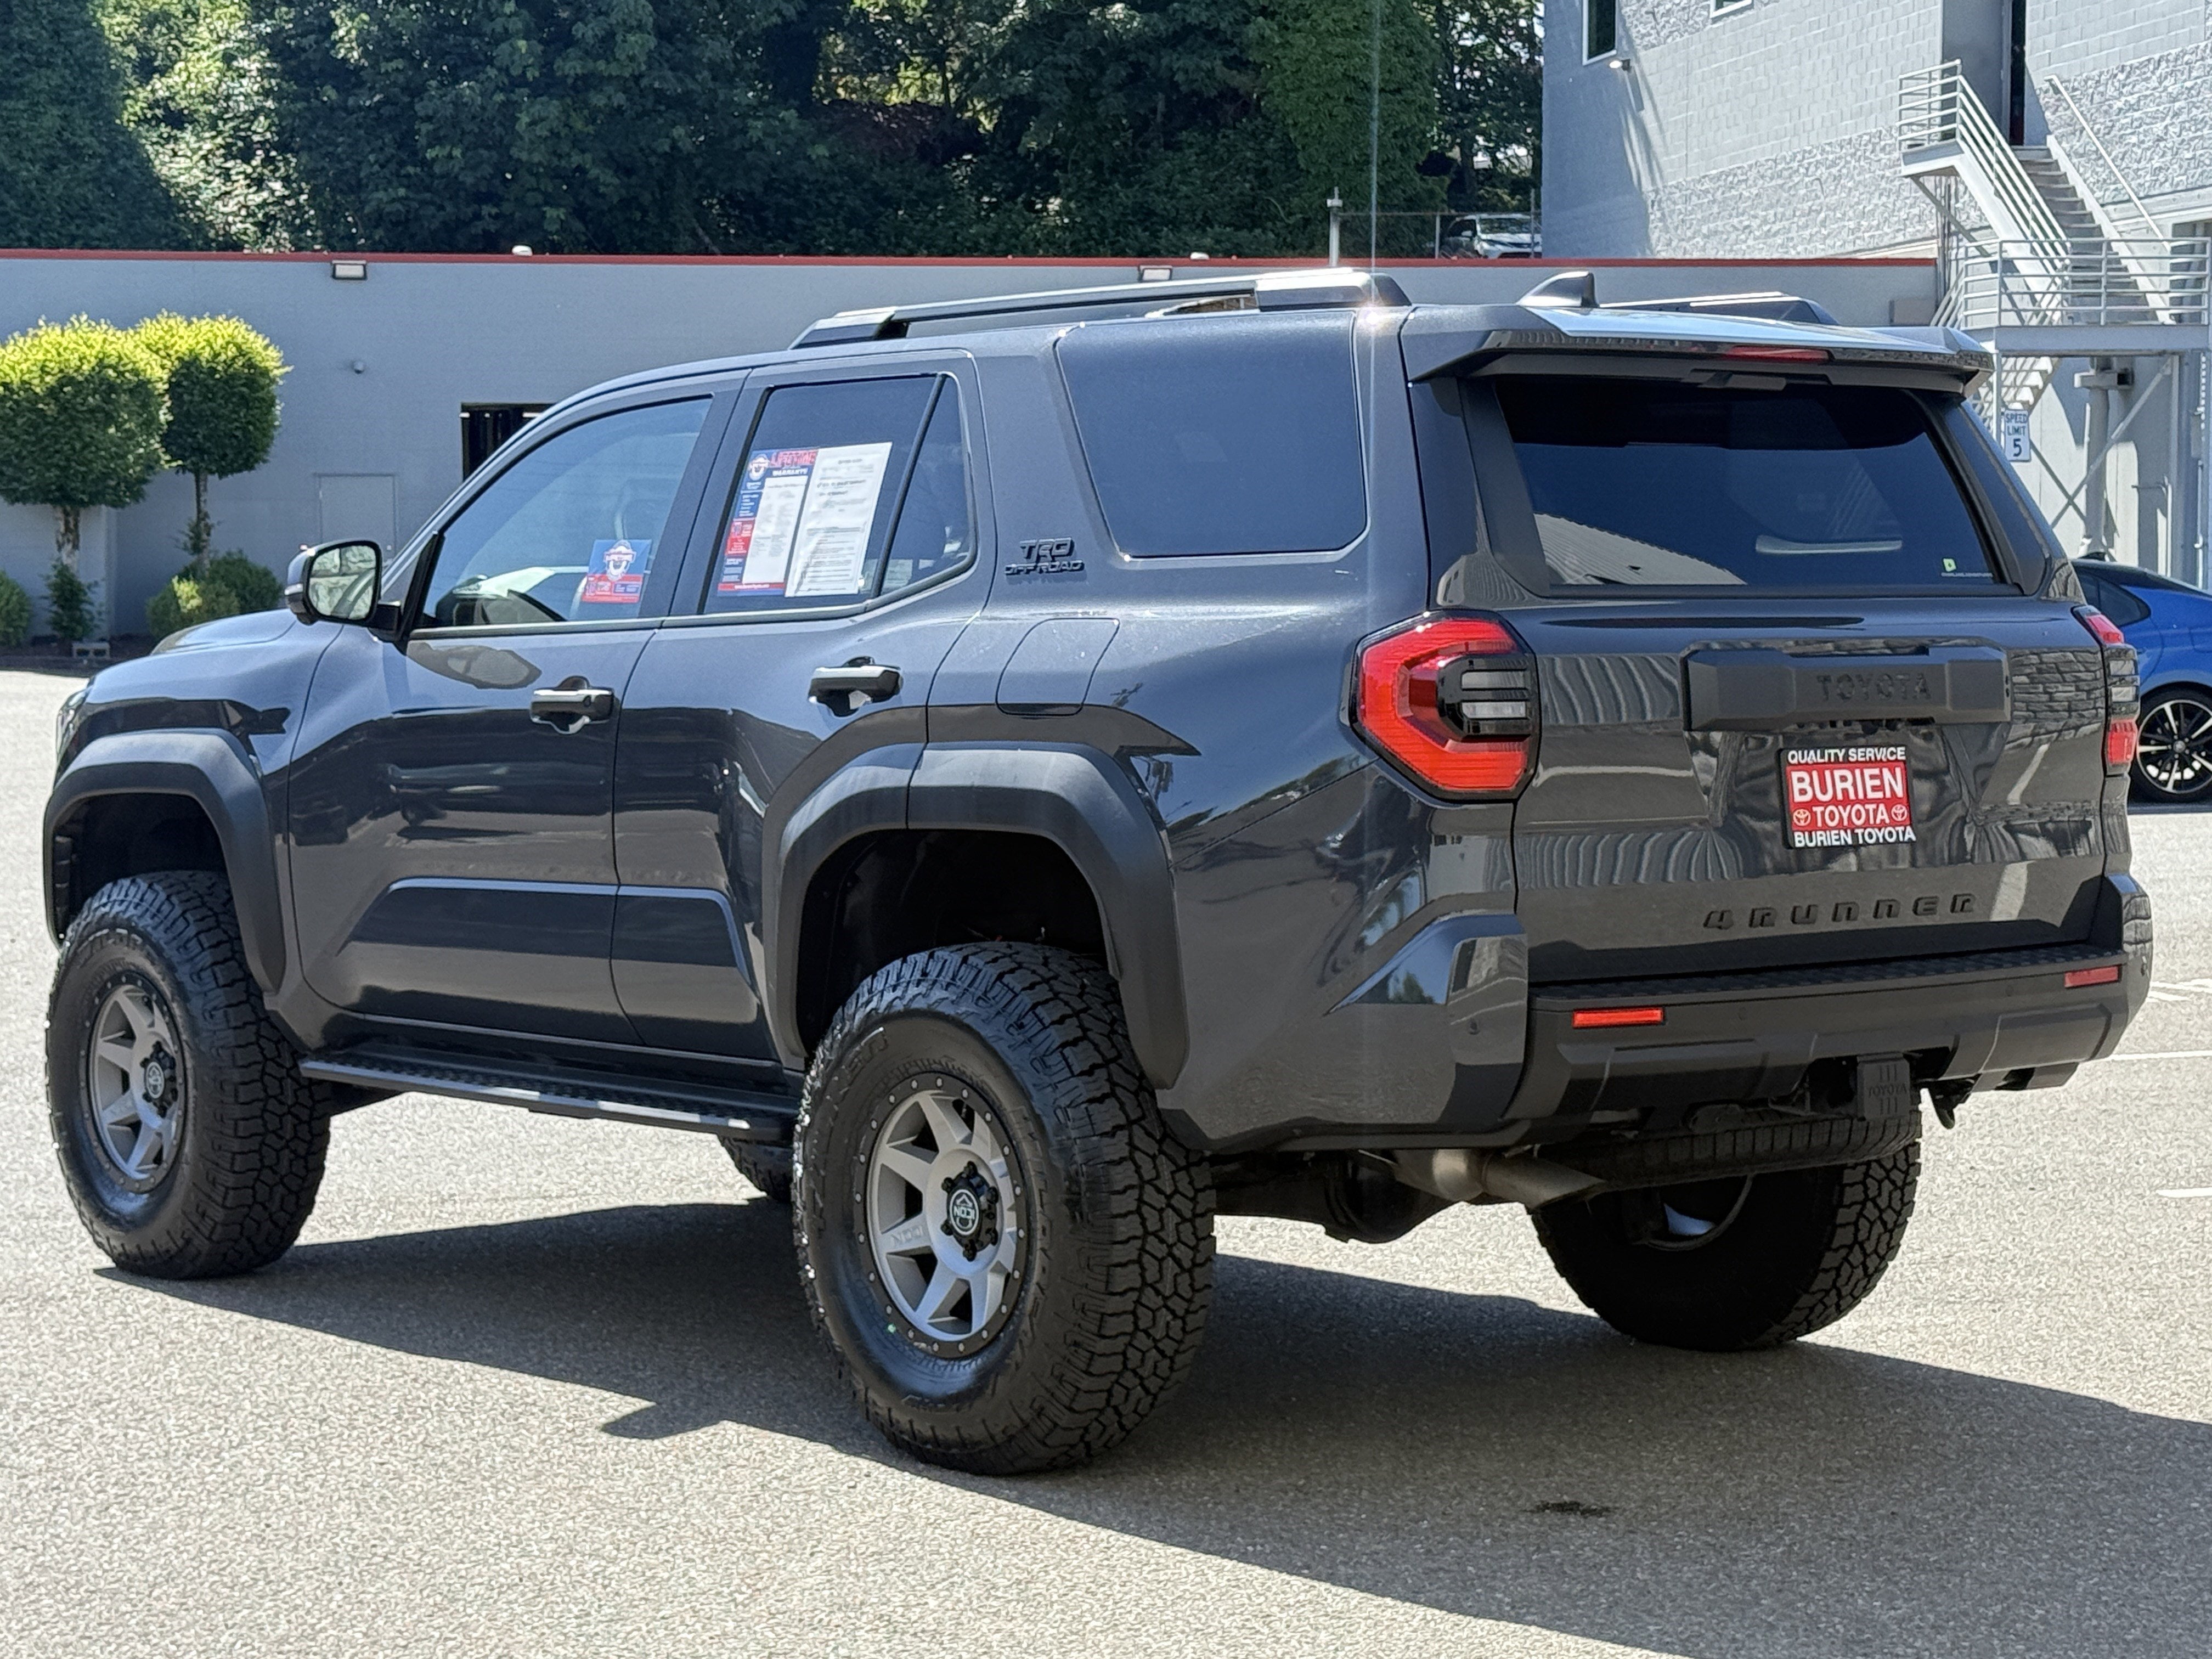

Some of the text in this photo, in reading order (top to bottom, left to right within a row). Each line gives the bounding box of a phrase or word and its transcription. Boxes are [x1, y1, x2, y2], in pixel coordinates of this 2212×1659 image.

[2005, 413, 2028, 424] SPEED
[2007, 425, 2026, 436] LIMIT
[2013, 438, 2022, 457] 5
[1019, 537, 1074, 563] TRD
[1816, 673, 1930, 700] TOYOTA
[1788, 746, 1906, 764] QUALITY SERVICE
[1791, 766, 1904, 803] BURIEN
[1812, 803, 1891, 827] TOYOTA
[1794, 825, 1916, 848] BURIEN TOYOTA
[1703, 893, 1976, 930] 4RUNNER
[953, 1205, 975, 1220] ICON
